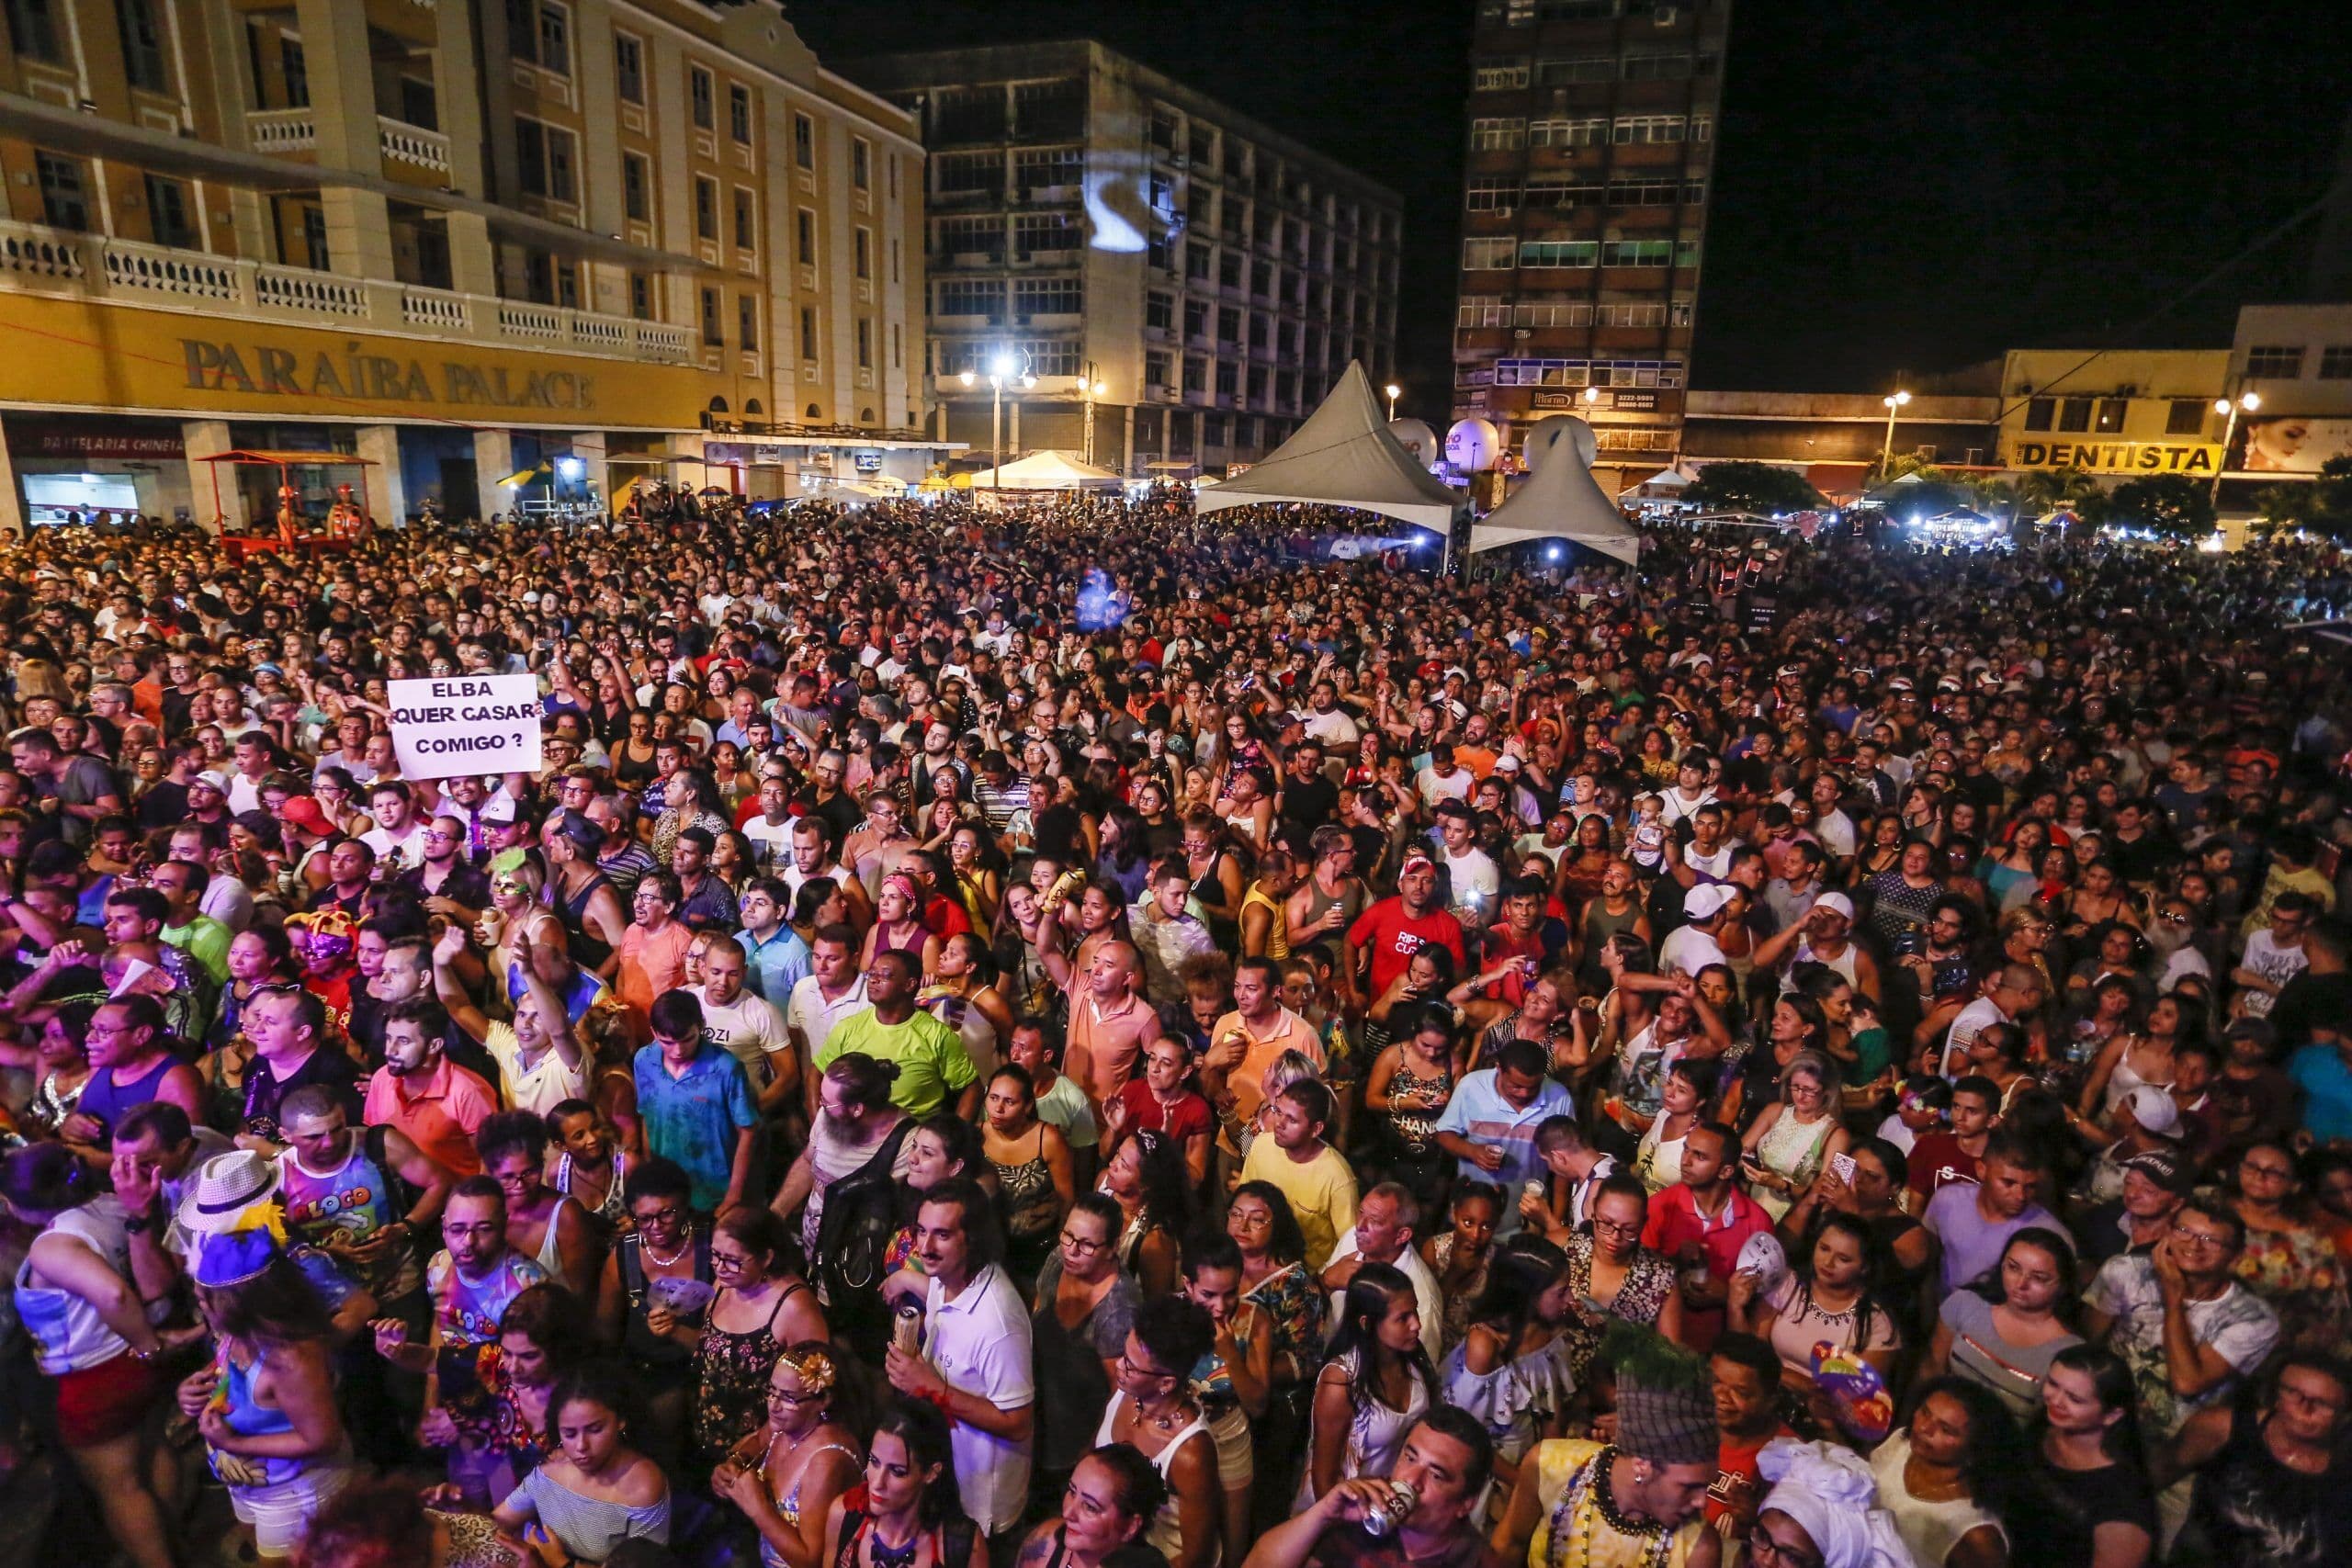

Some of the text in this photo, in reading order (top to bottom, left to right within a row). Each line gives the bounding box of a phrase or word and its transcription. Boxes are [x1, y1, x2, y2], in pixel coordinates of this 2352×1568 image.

[177, 338, 595, 410] PARAÍBA PALACE
[2023, 444, 2211, 469] DENTISTA
[431, 682, 493, 697] ELBA
[394, 704, 536, 724] QUER CASAR
[415, 733, 523, 753] COMIGO ?
[1397, 931, 1418, 944] RIP
[293, 1186, 371, 1220] BLOCO
